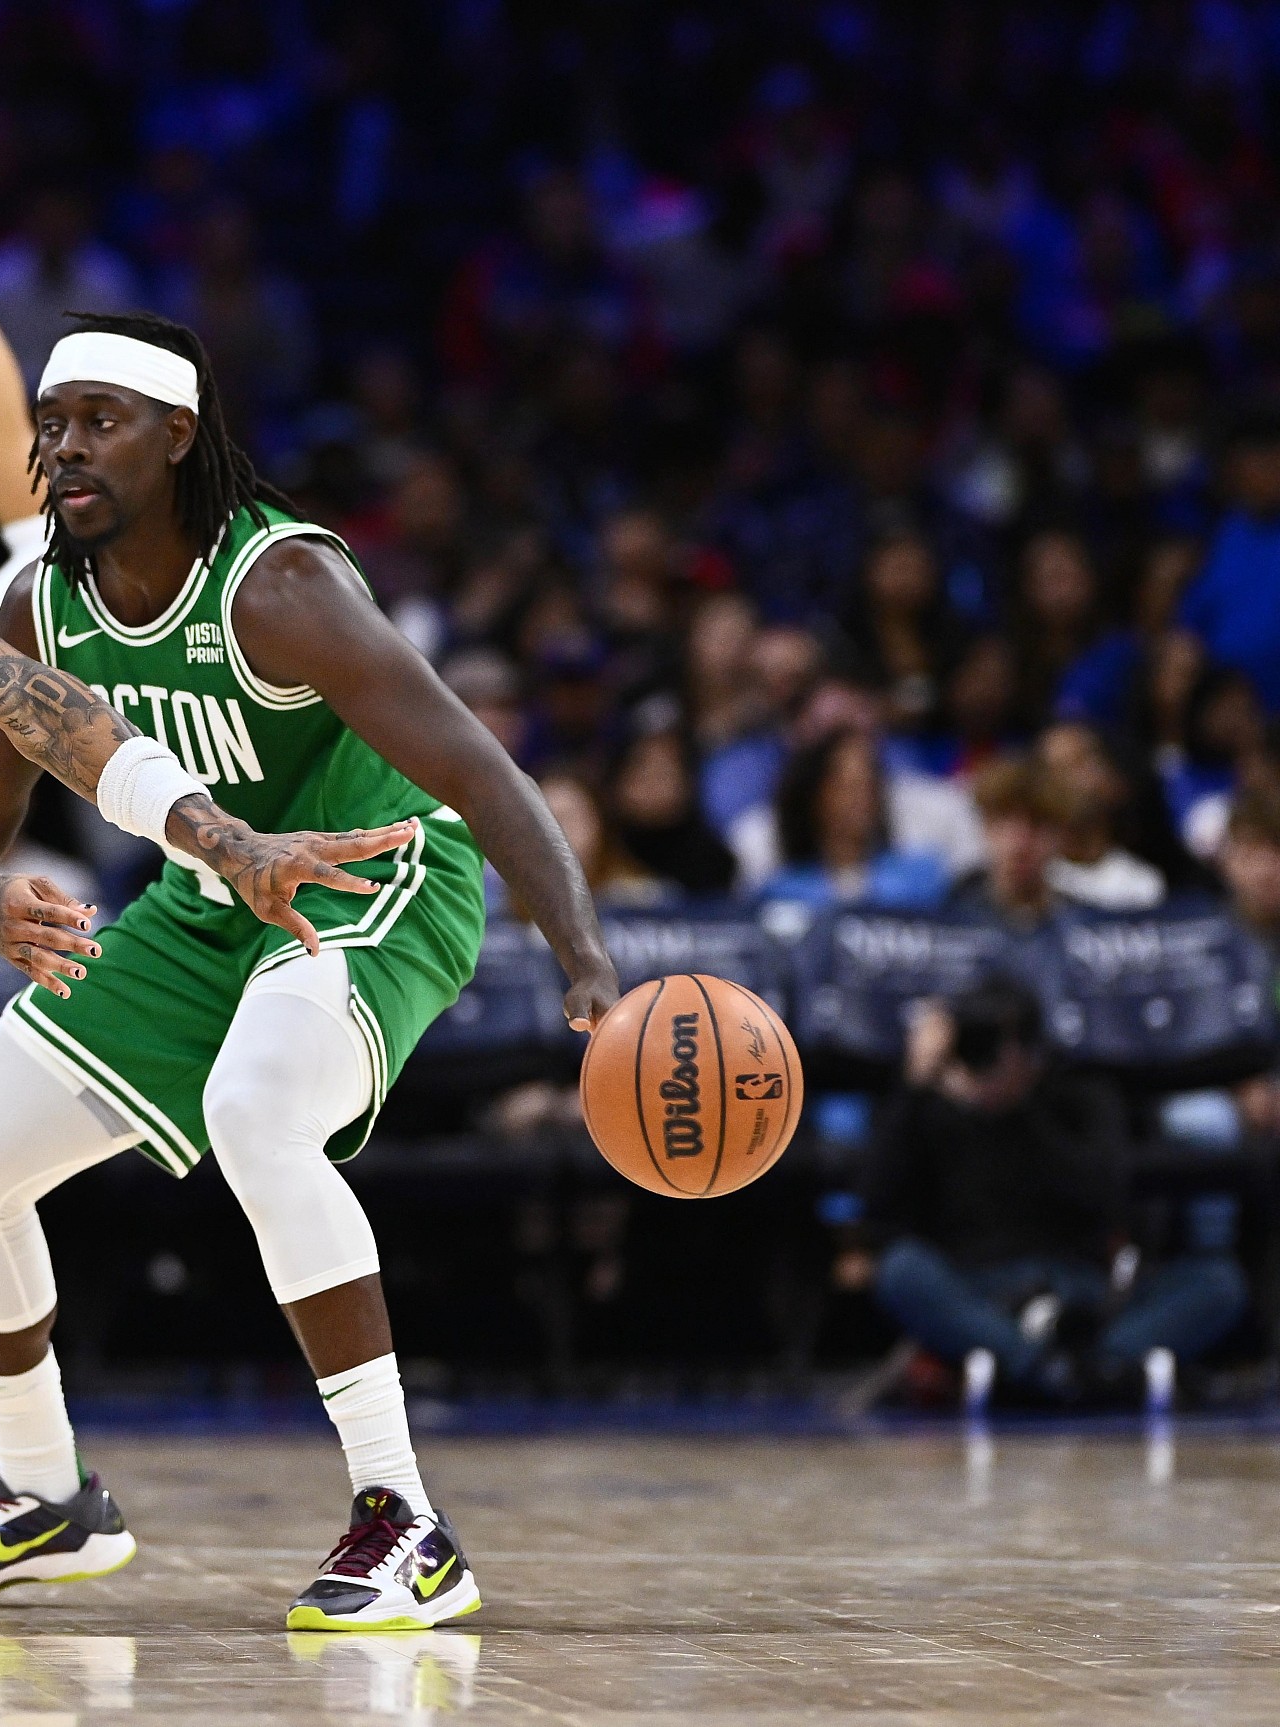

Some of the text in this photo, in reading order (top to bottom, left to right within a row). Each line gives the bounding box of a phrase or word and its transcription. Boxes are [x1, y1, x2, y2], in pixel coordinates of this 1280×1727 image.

[184, 622, 224, 647] VISTA
[186, 646, 224, 664] PRINT
[659, 1012, 705, 1160] Wilson
